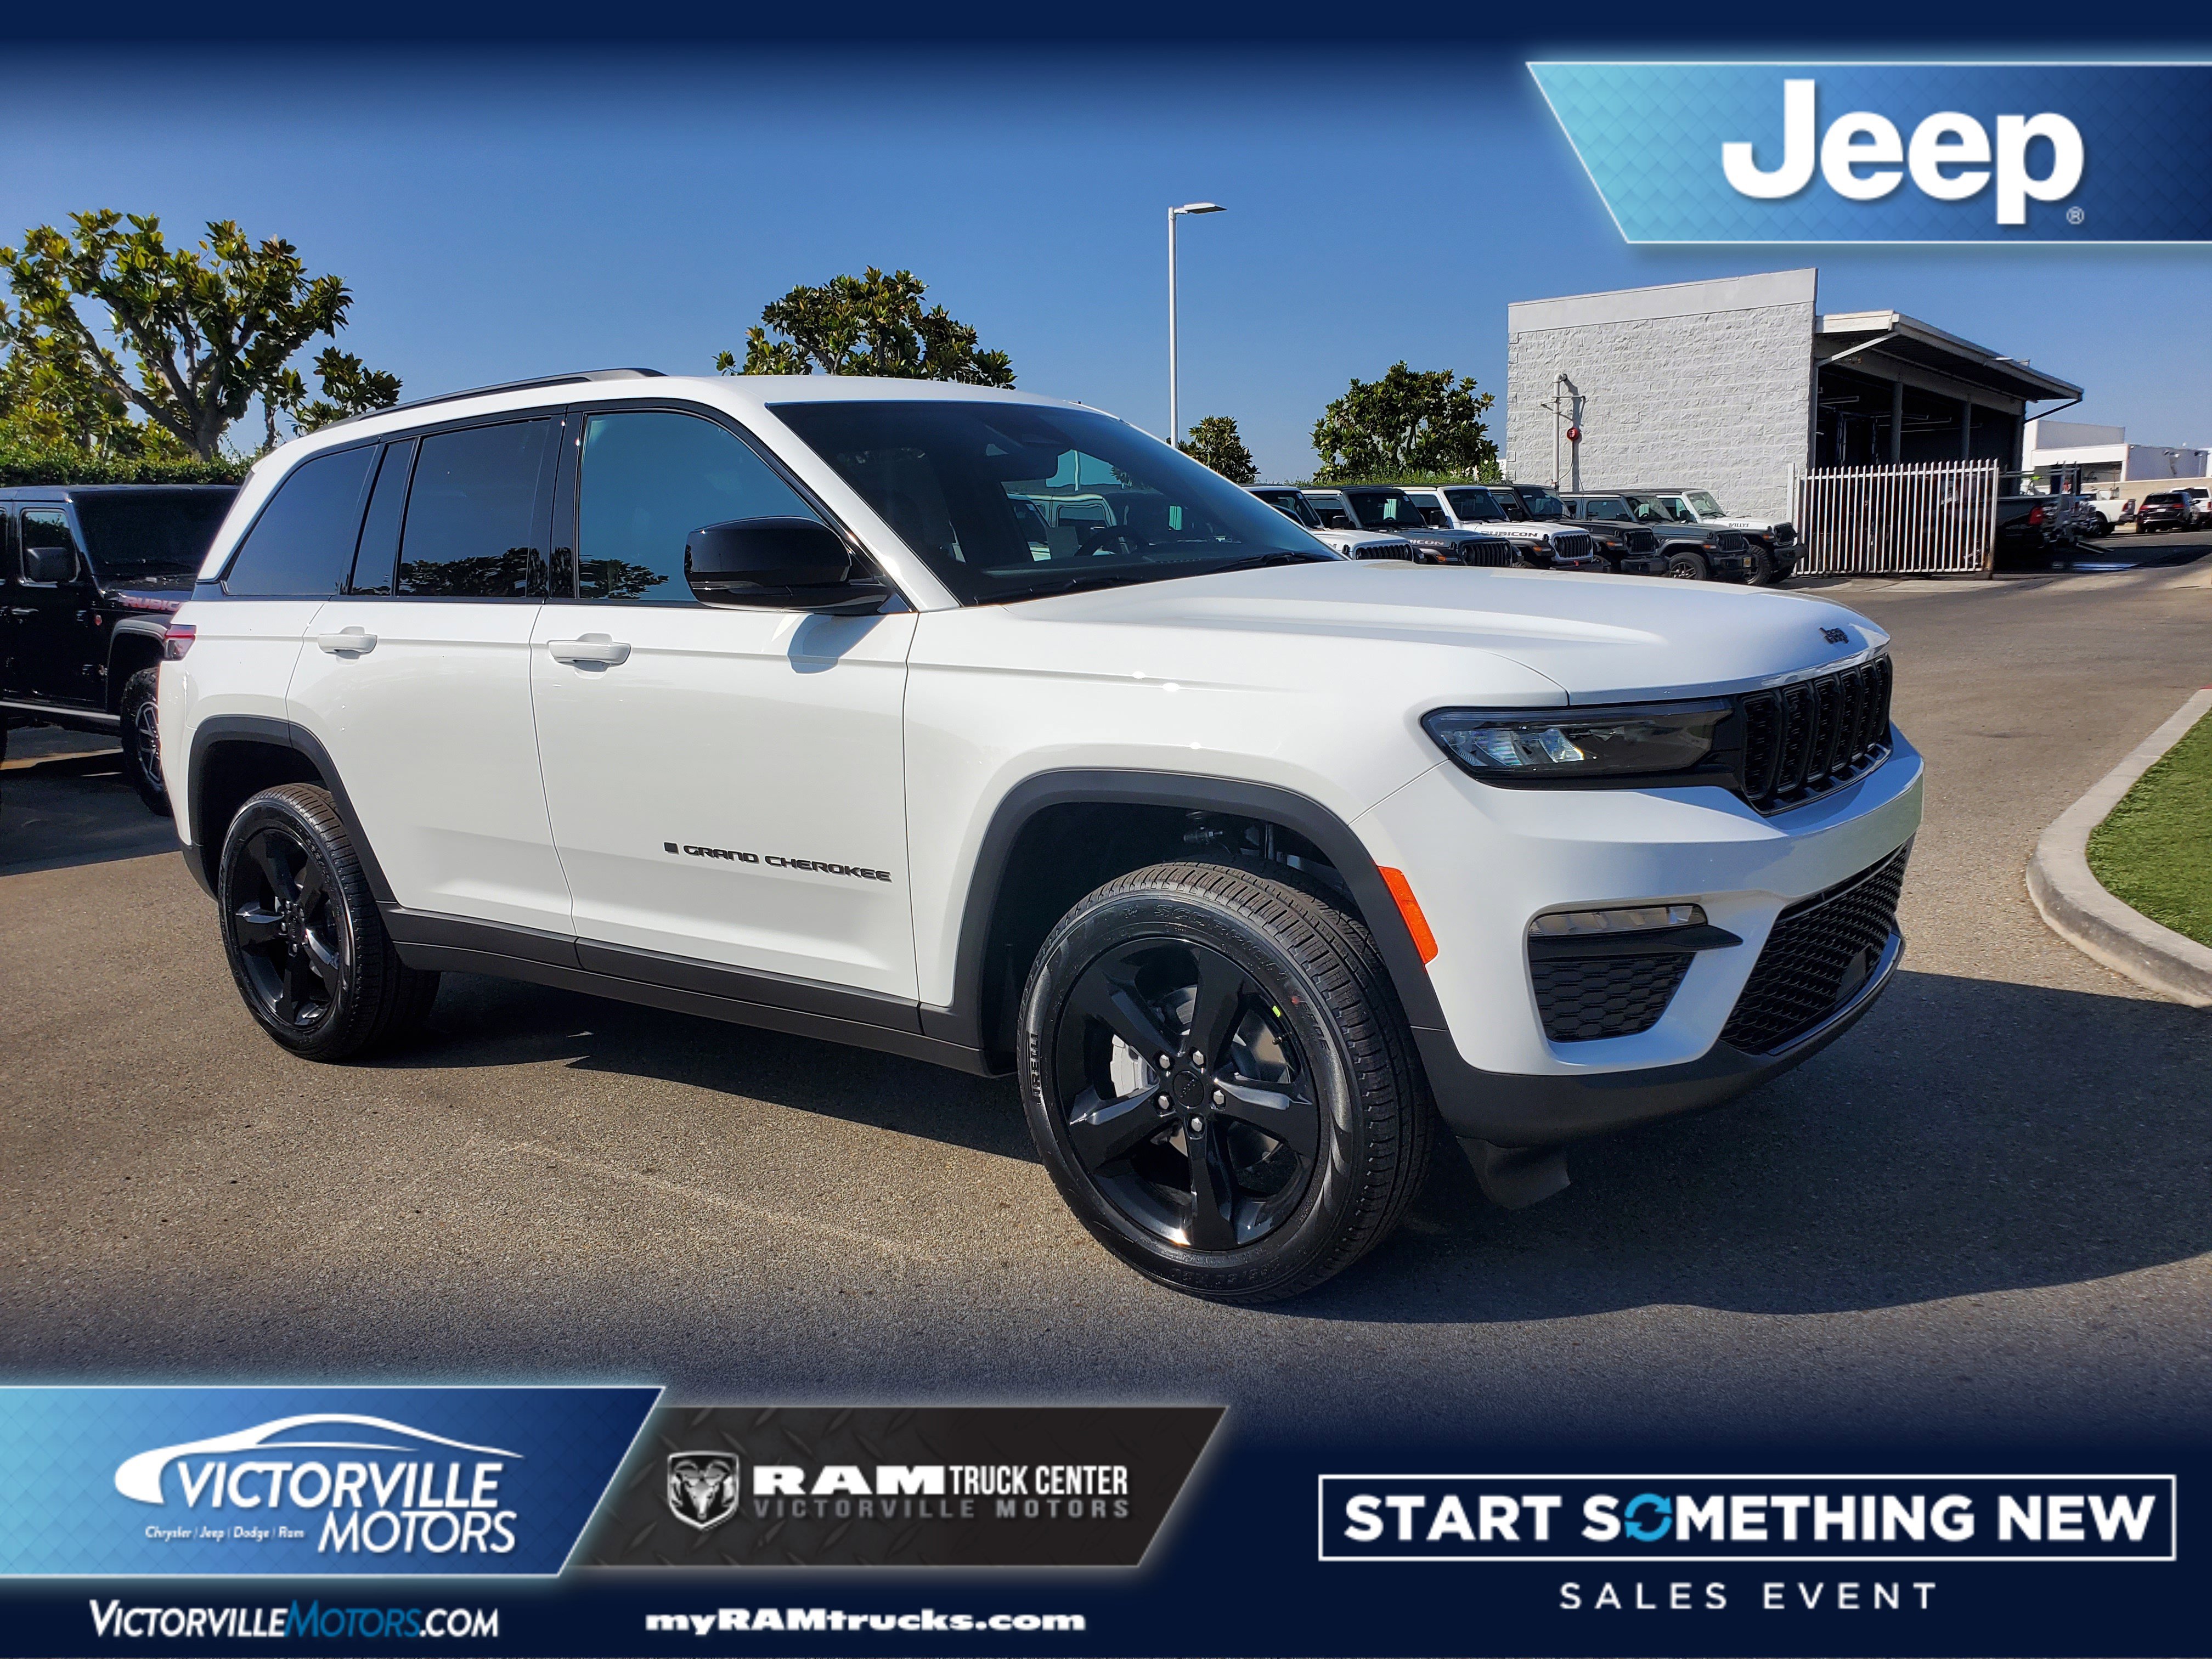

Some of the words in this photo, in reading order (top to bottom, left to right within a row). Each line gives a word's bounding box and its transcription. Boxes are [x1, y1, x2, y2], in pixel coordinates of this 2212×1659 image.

[121, 595, 180, 612] RUBIC
[682, 844, 760, 865] GRAND
[764, 855, 893, 883] CHEROKEE
